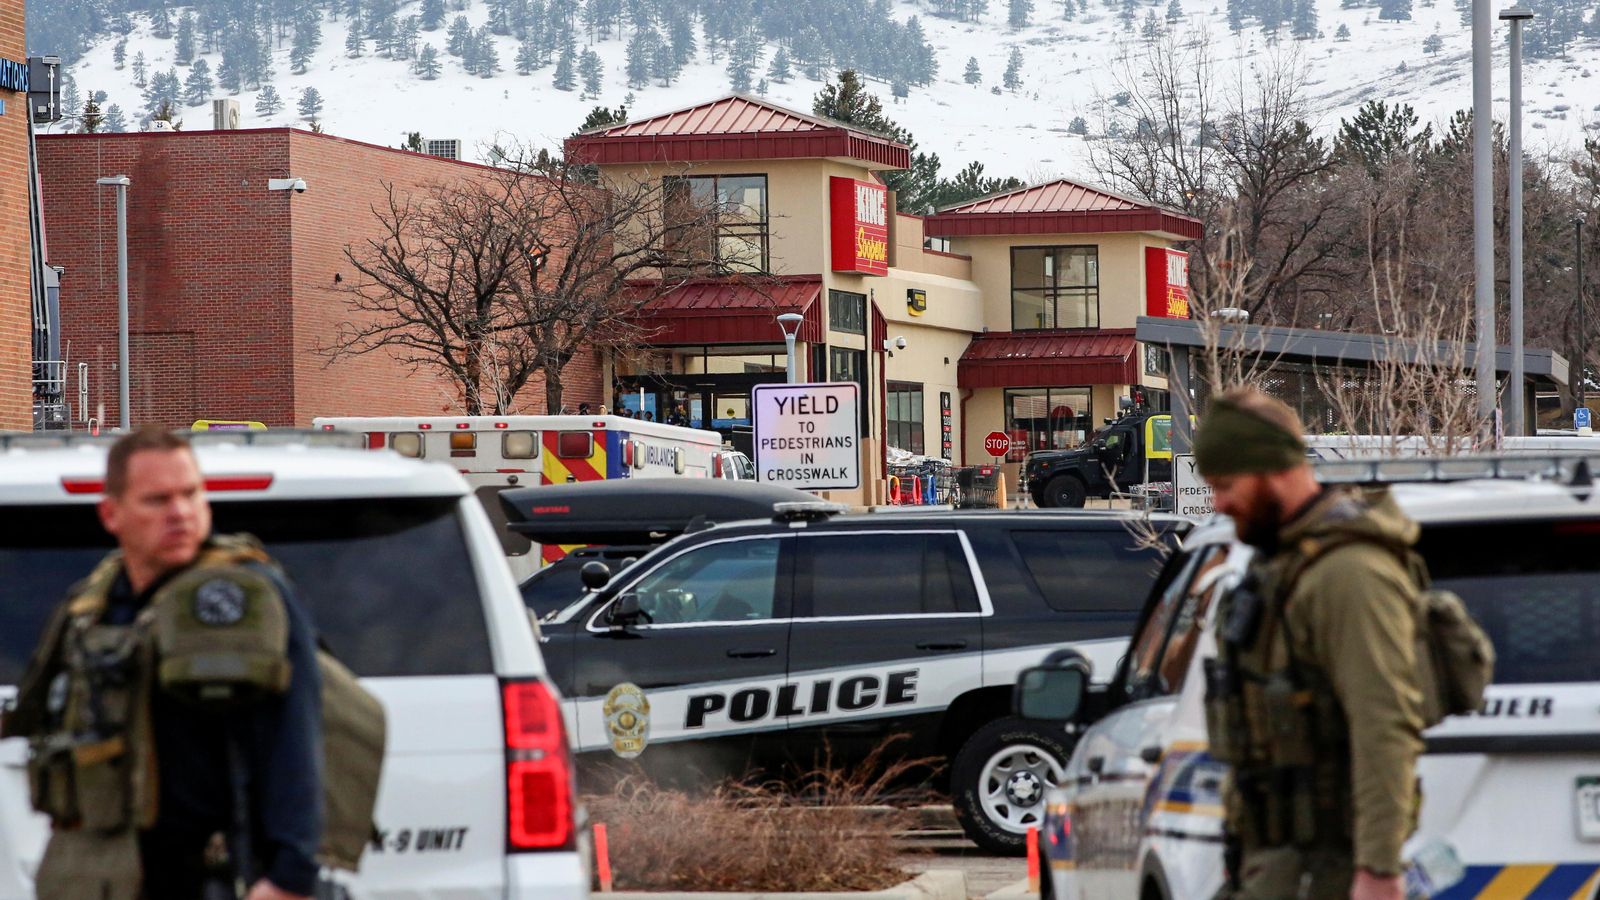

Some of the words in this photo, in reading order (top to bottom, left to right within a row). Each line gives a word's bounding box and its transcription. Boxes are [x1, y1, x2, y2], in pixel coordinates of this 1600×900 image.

[0, 57, 29, 92] ATIONS
[857, 185, 885, 226] KING
[774, 395, 839, 416] YIELD
[798, 421, 815, 433] TO
[761, 436, 853, 450] PEDESTRIANS
[986, 438, 1009, 450] STOP
[646, 445, 674, 468] MBULANCE
[800, 453, 814, 465] IN
[768, 467, 849, 481] CROSSWALK
[683, 668, 921, 730] POLICE
[416, 826, 468, 852] UNIT
